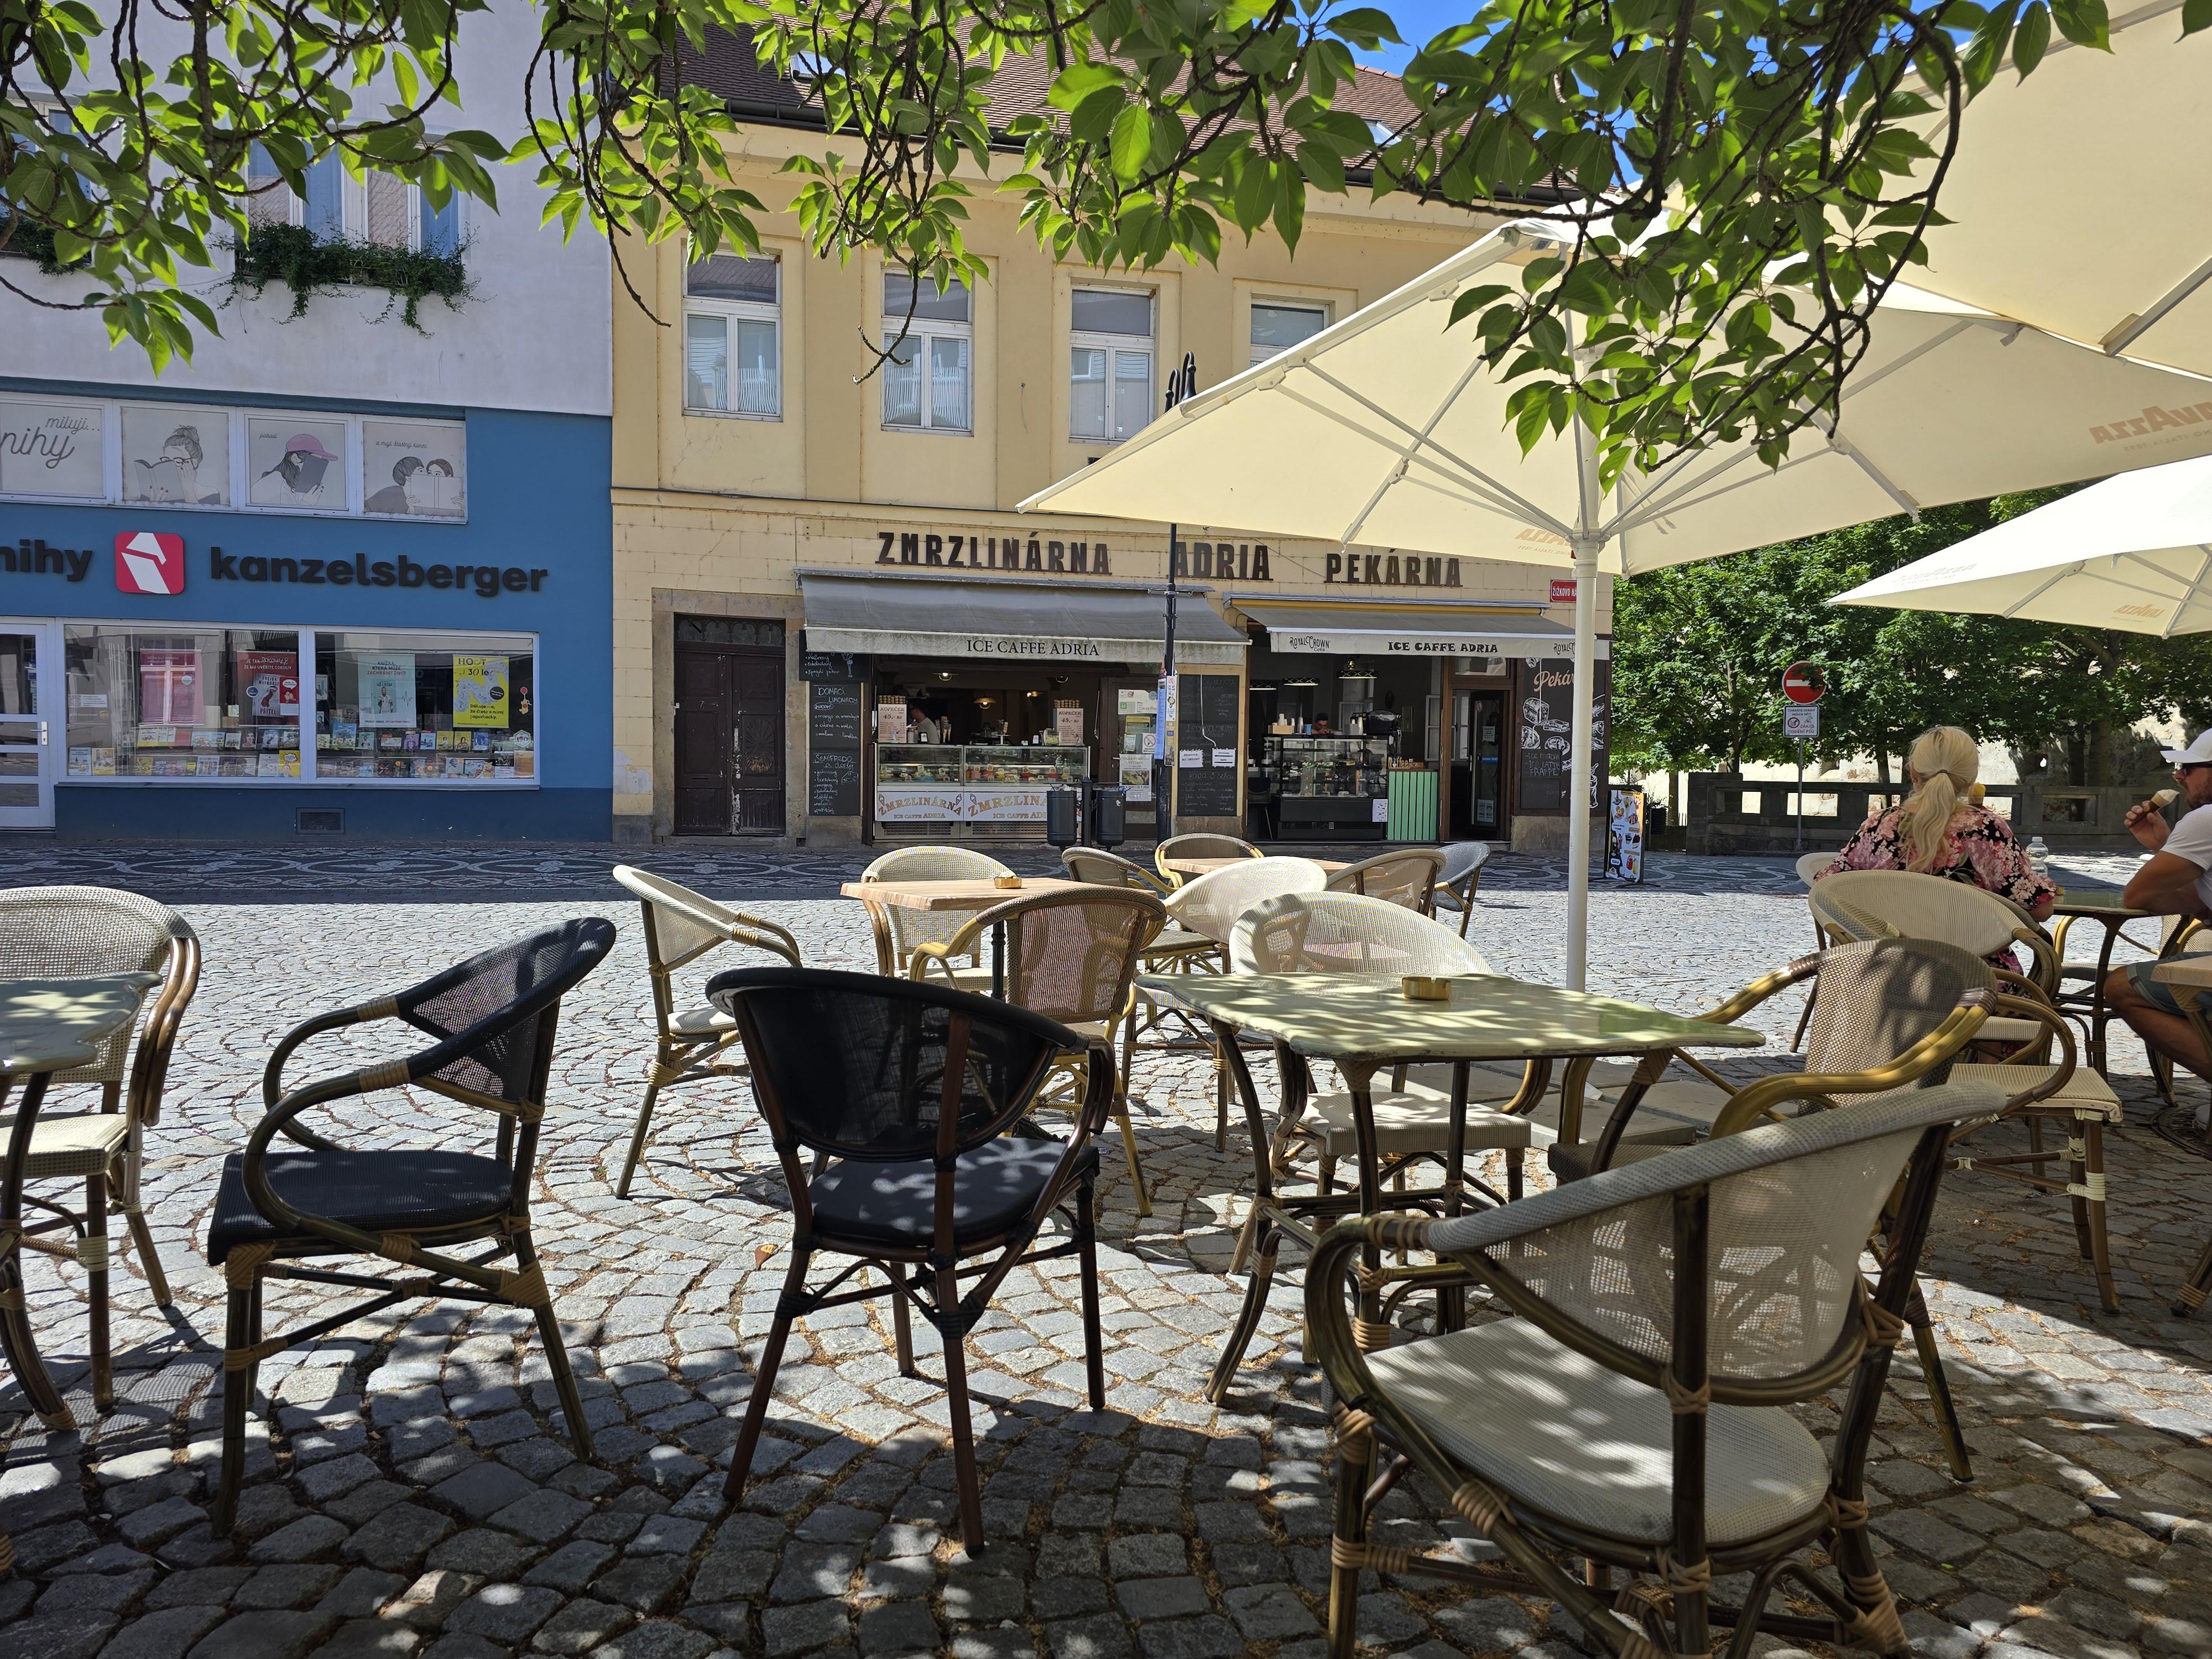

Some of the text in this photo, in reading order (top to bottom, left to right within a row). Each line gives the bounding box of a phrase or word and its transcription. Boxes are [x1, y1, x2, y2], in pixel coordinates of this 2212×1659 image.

[0, 426, 75, 469] nihy
[878, 531, 1462, 586] ZMRZLINÁRNA ADRIA PEKÁRNA
[0, 539, 548, 598] nihy kanzelsberger
[1553, 586, 1571, 596] ŽIŽKOVO
[967, 640, 1099, 656] ICE CAFFE ADRIA
[1290, 636, 1329, 649] ROYAL CROWN
[1387, 641, 1498, 653] ICE CAFFE ADRIA
[1553, 643, 1569, 655] ROYAL
[879, 796, 962, 816] ZMRZLINÁRNA
